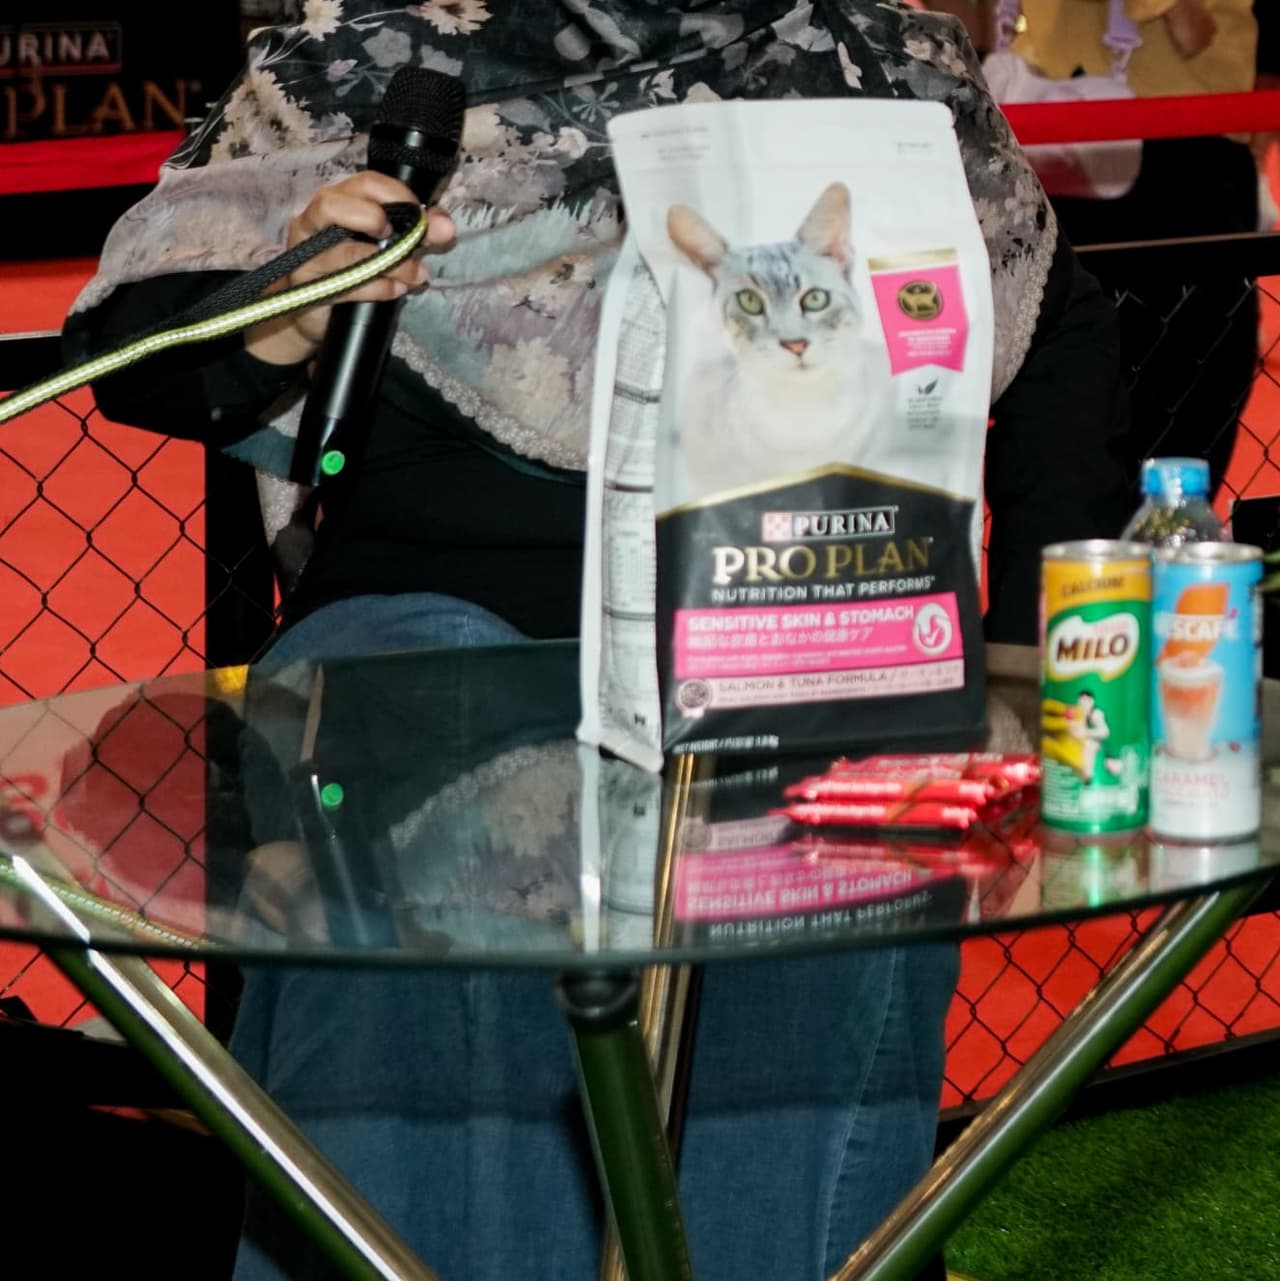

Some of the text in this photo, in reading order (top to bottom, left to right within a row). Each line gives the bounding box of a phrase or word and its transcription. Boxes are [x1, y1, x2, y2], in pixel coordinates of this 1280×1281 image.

[3, 79, 186, 138] PLAN
[793, 511, 890, 536] PURINA
[712, 541, 930, 584] PRO PLAN
[712, 578, 931, 602] NUTRITION THAT PERFORMS
[688, 606, 914, 632] SENSITIVE SKIN & STOMACH
[1056, 633, 1129, 663] MILO
